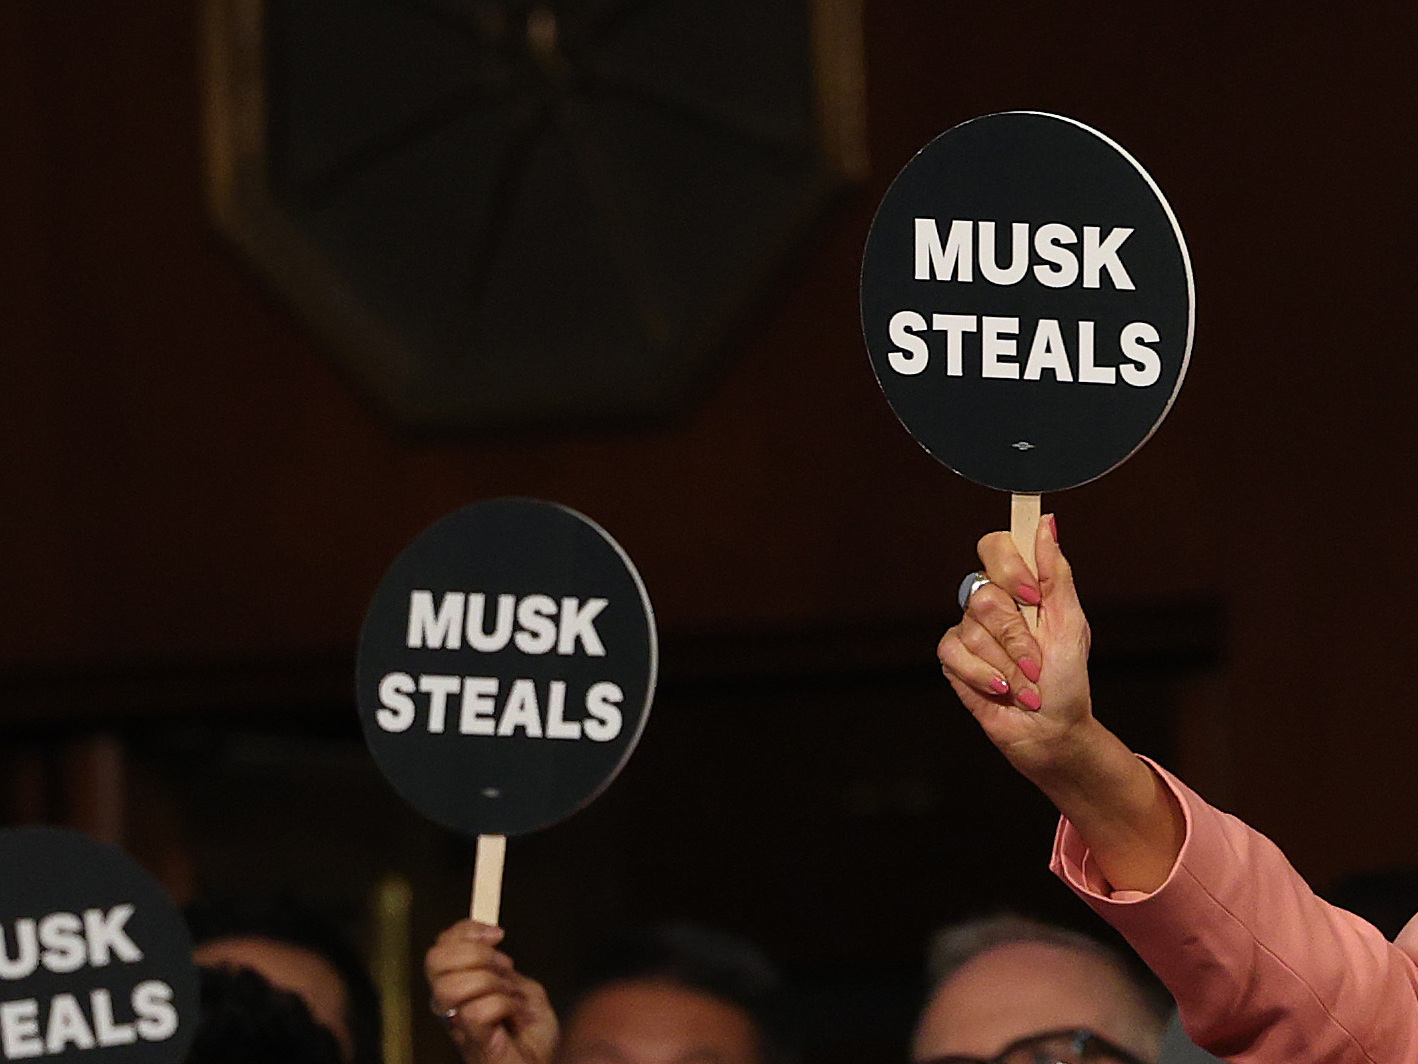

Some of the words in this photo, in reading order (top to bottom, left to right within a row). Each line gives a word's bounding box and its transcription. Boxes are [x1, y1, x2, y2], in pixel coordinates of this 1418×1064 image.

[914, 217, 1136, 291] MUSK
[887, 310, 1161, 387] STEALS
[406, 589, 610, 657] MUSK
[375, 671, 625, 743] STEALS
